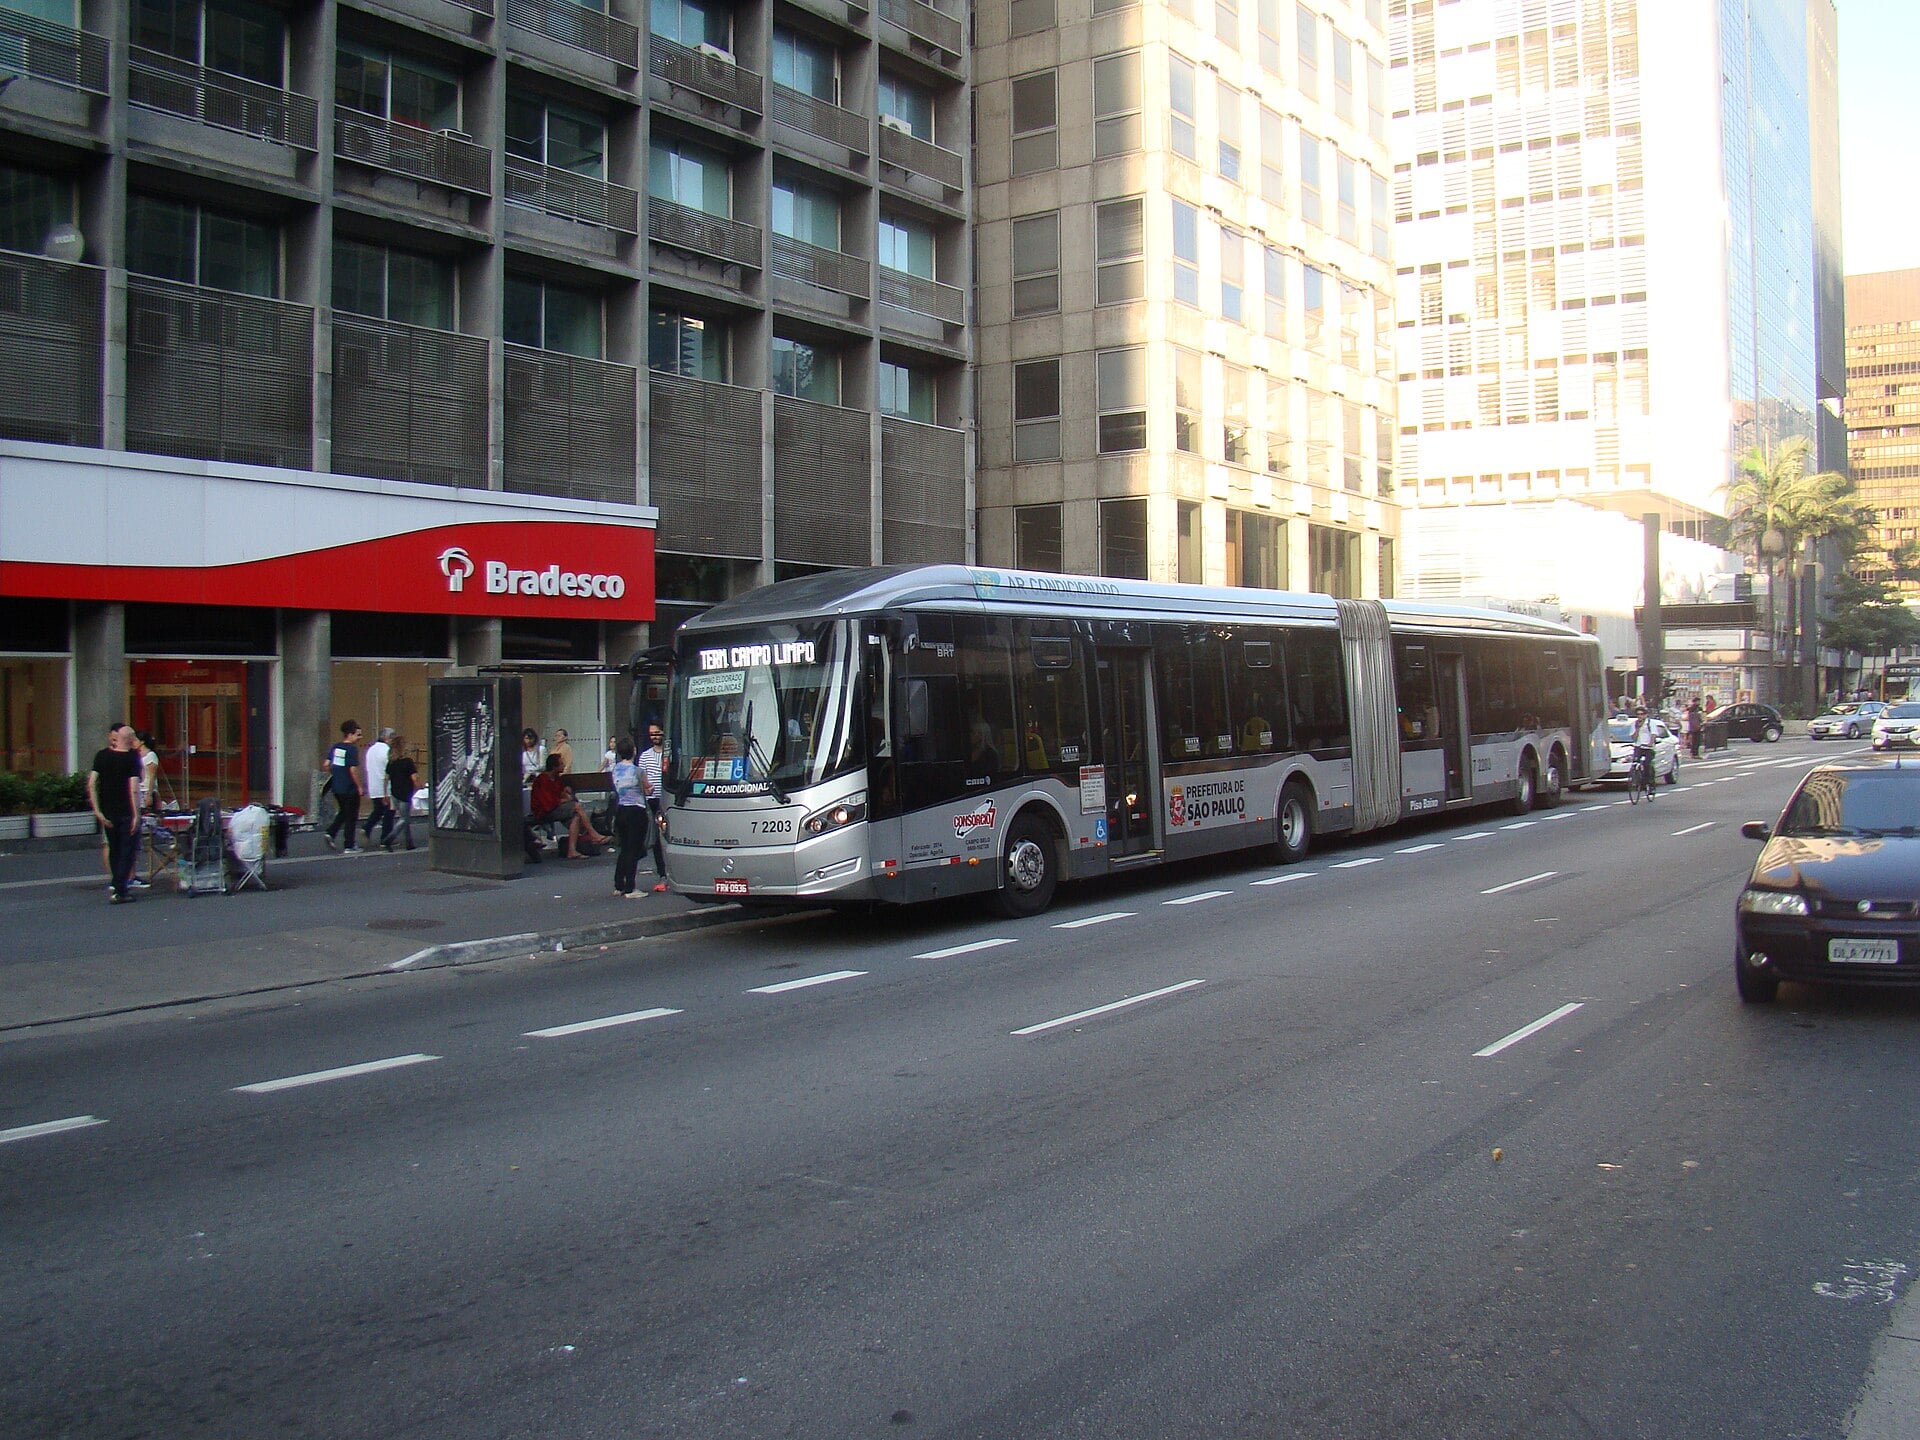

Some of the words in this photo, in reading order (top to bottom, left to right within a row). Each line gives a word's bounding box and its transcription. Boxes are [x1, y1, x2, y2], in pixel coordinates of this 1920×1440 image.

[486, 561, 625, 599] Bradesco
[1008, 576, 1025, 595] AR
[1030, 578, 1120, 600] CONDICIONADO
[731, 645, 771, 668] CAMPO
[774, 641, 815, 665] LIMPO
[937, 648, 954, 658] BRT
[704, 785, 716, 794] AR
[1186, 782, 1233, 798] PREFEITURA
[1234, 780, 1244, 793] DE
[1187, 799, 1210, 821] SÃO
[1211, 797, 1245, 817] PAULO
[751, 822, 758, 833] 7
[761, 820, 792, 833] 2203
